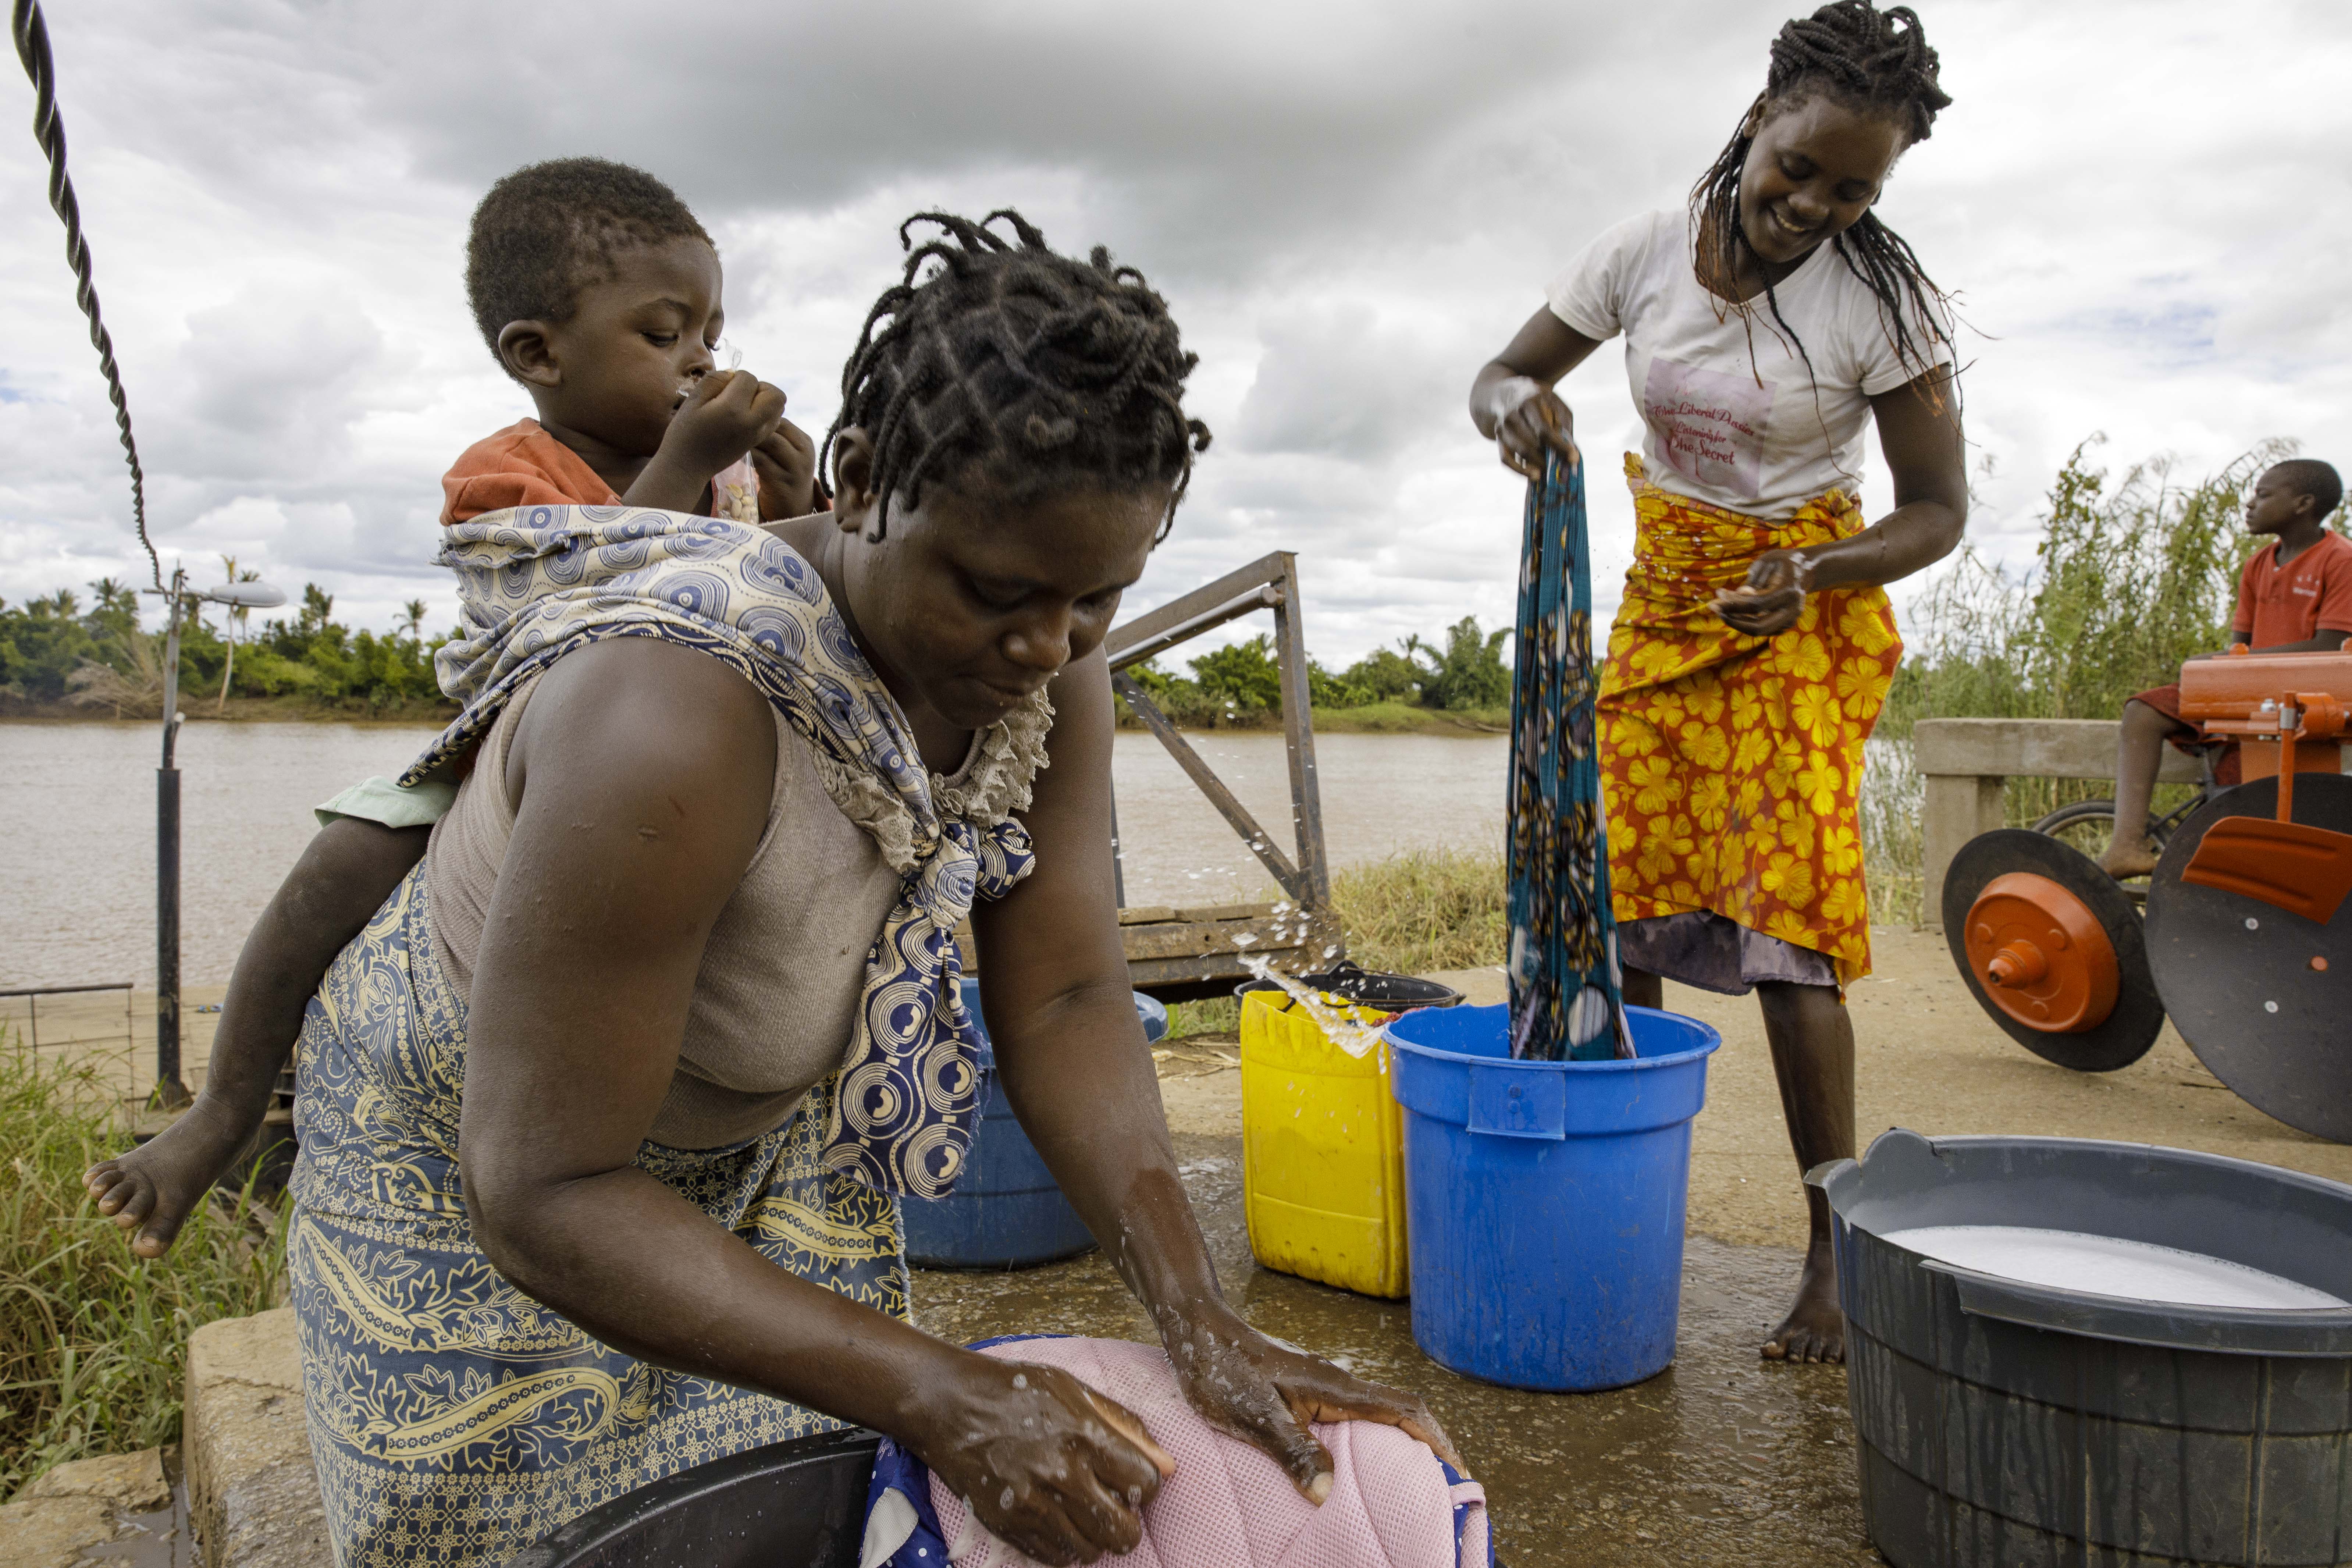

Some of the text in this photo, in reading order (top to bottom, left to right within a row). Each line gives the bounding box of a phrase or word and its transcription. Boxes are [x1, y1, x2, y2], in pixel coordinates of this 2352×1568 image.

[1653, 405, 1676, 417] The
[1676, 401, 1716, 419] Liberal
[1671, 436, 1735, 465] The Secret
